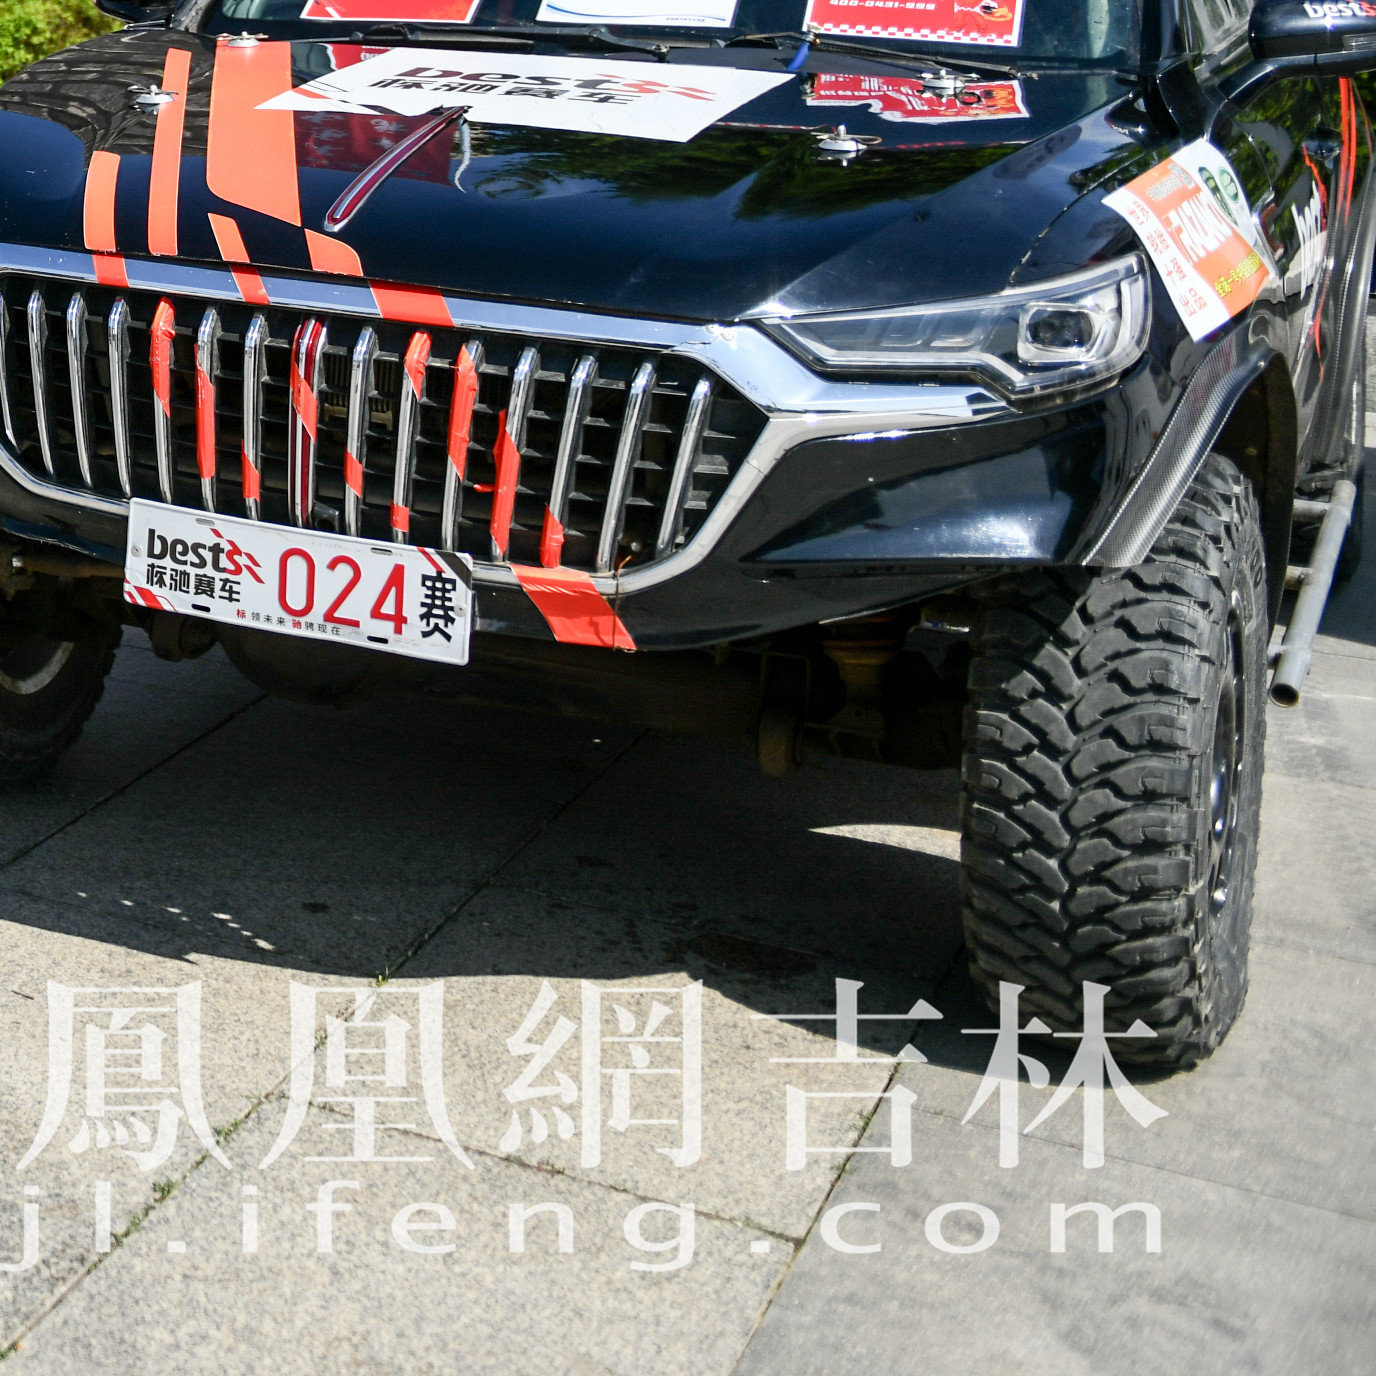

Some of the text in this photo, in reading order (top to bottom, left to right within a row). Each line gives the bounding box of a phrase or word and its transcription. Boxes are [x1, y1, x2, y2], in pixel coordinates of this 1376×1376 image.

[146, 562, 241, 603] 标驰赛车
[278, 547, 408, 636] 024
[420, 570, 457, 643] 赛
